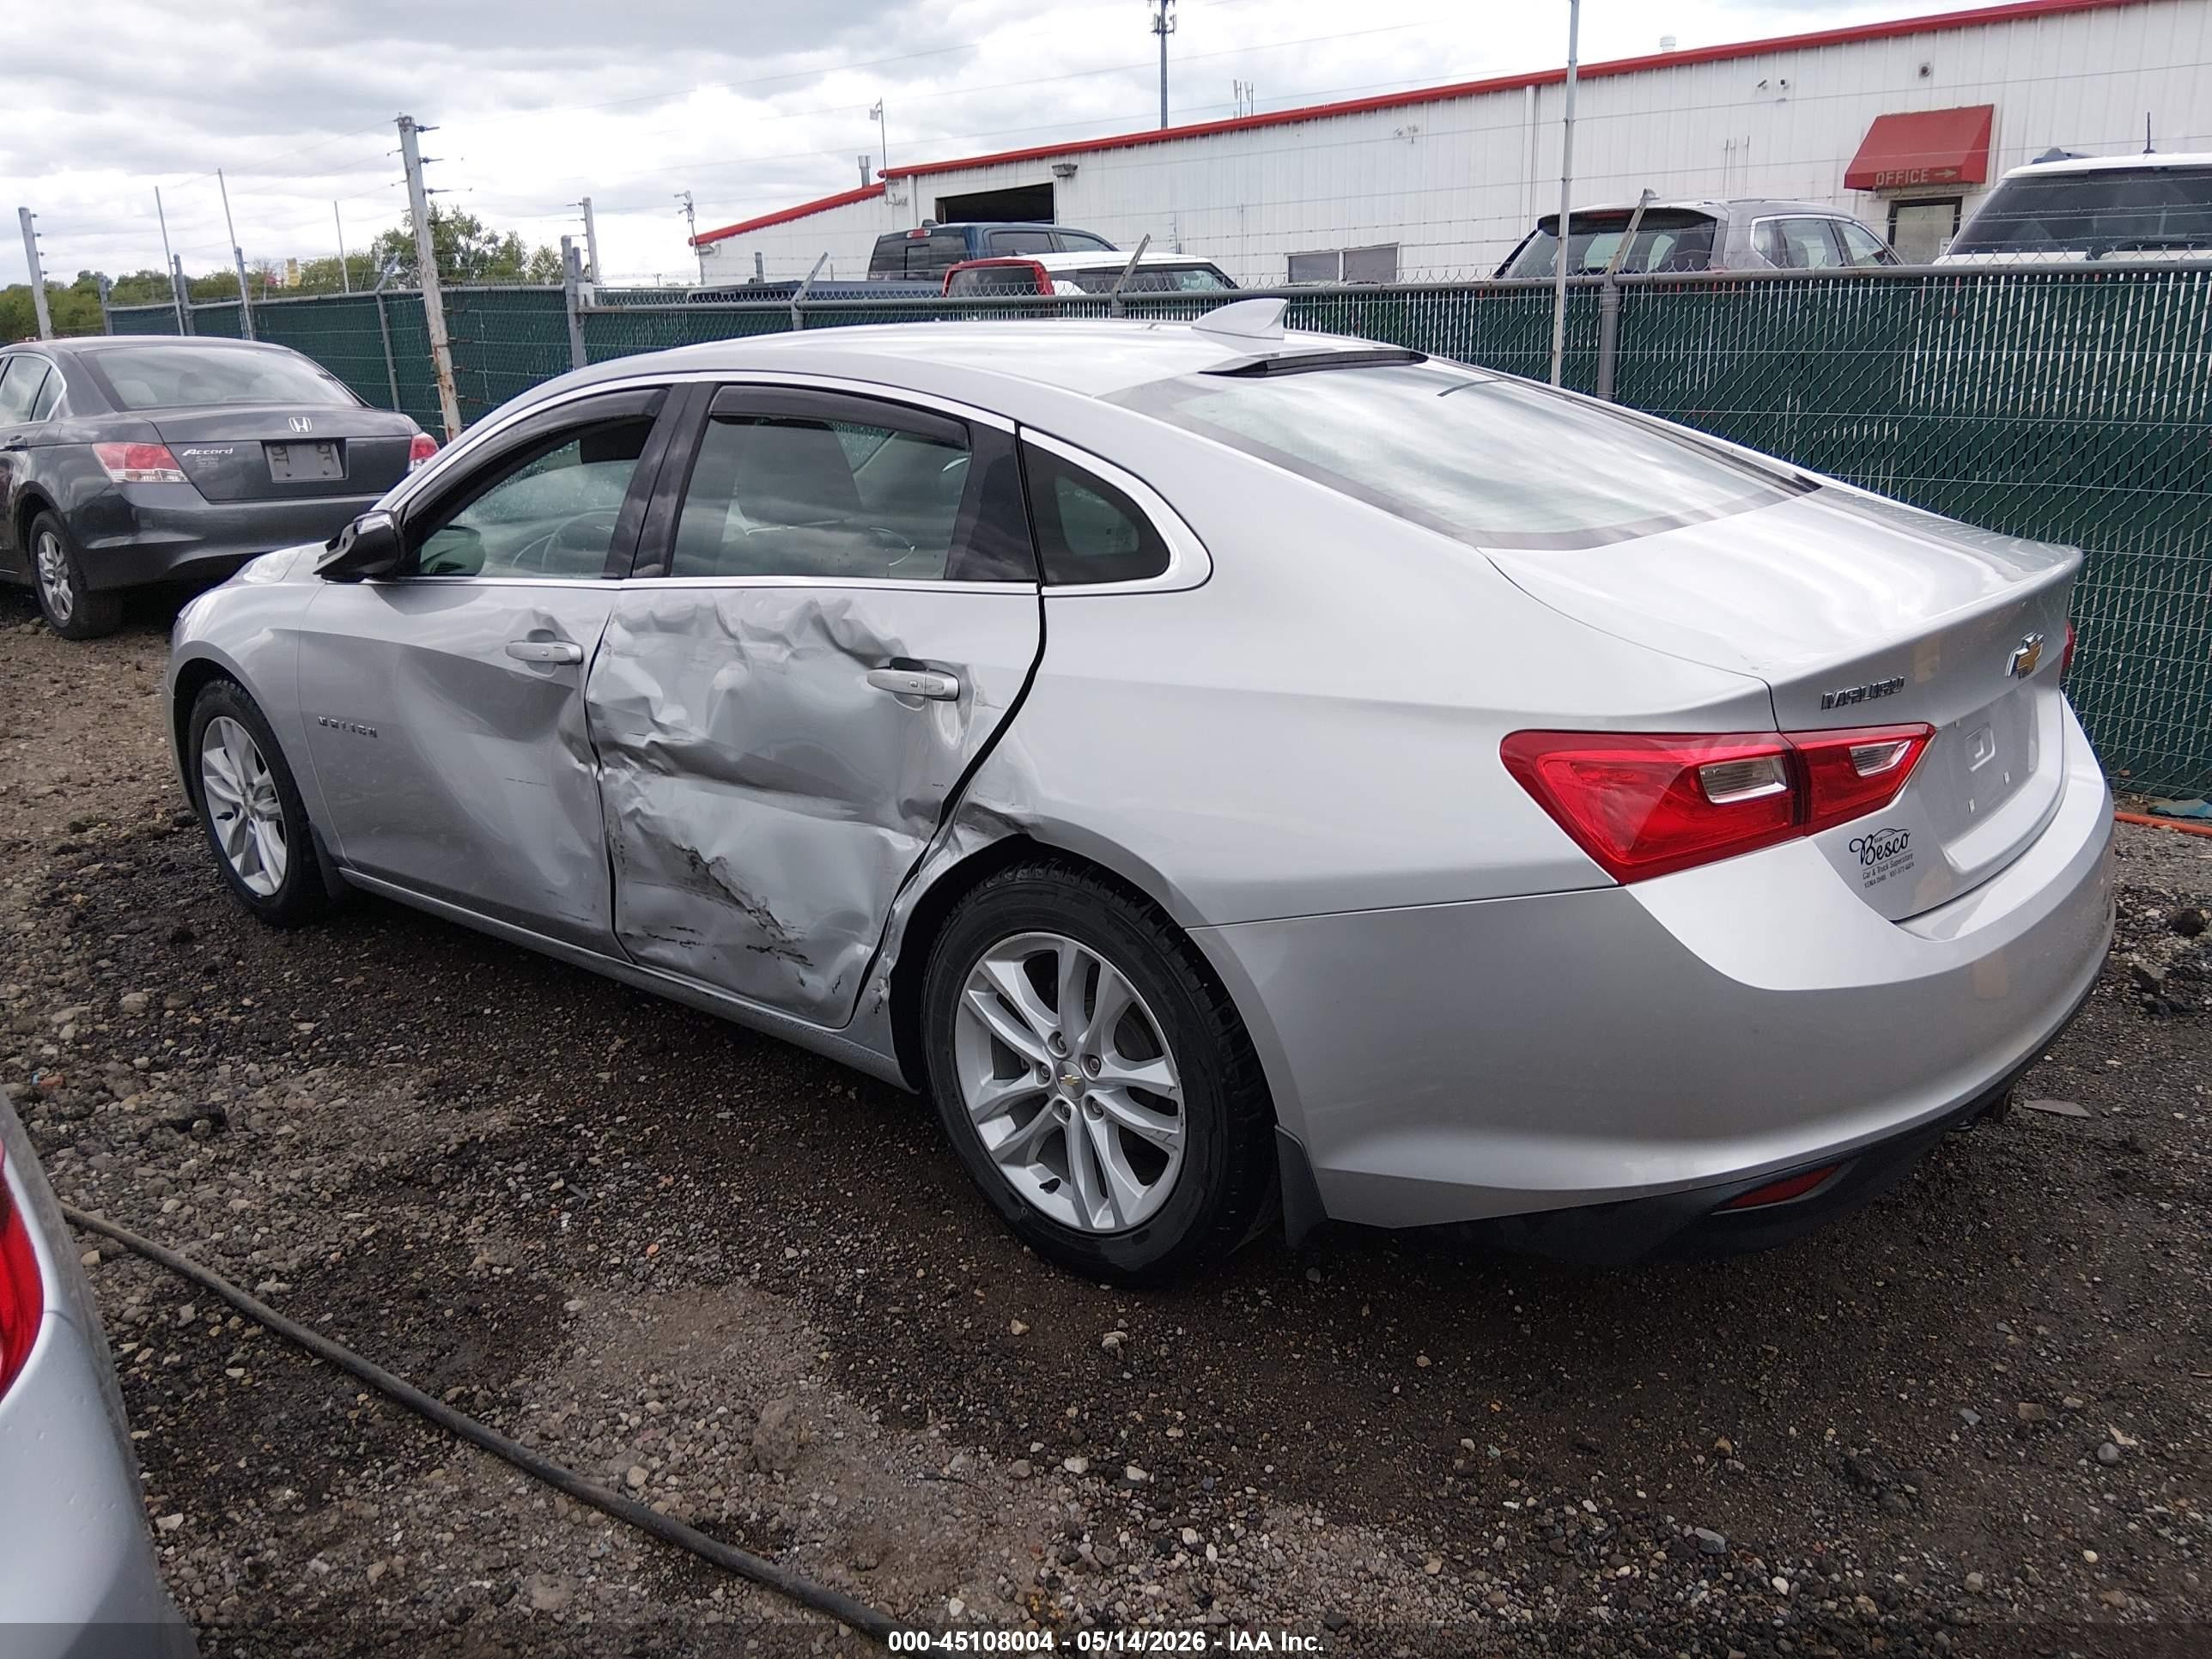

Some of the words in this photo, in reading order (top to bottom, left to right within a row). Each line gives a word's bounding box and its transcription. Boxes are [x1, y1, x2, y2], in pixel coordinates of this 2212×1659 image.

[1875, 168, 1929, 185] OFFICE
[182, 447, 234, 456] Accord
[1821, 676, 1905, 710] MALIBU
[1849, 833, 1911, 866] Besco
